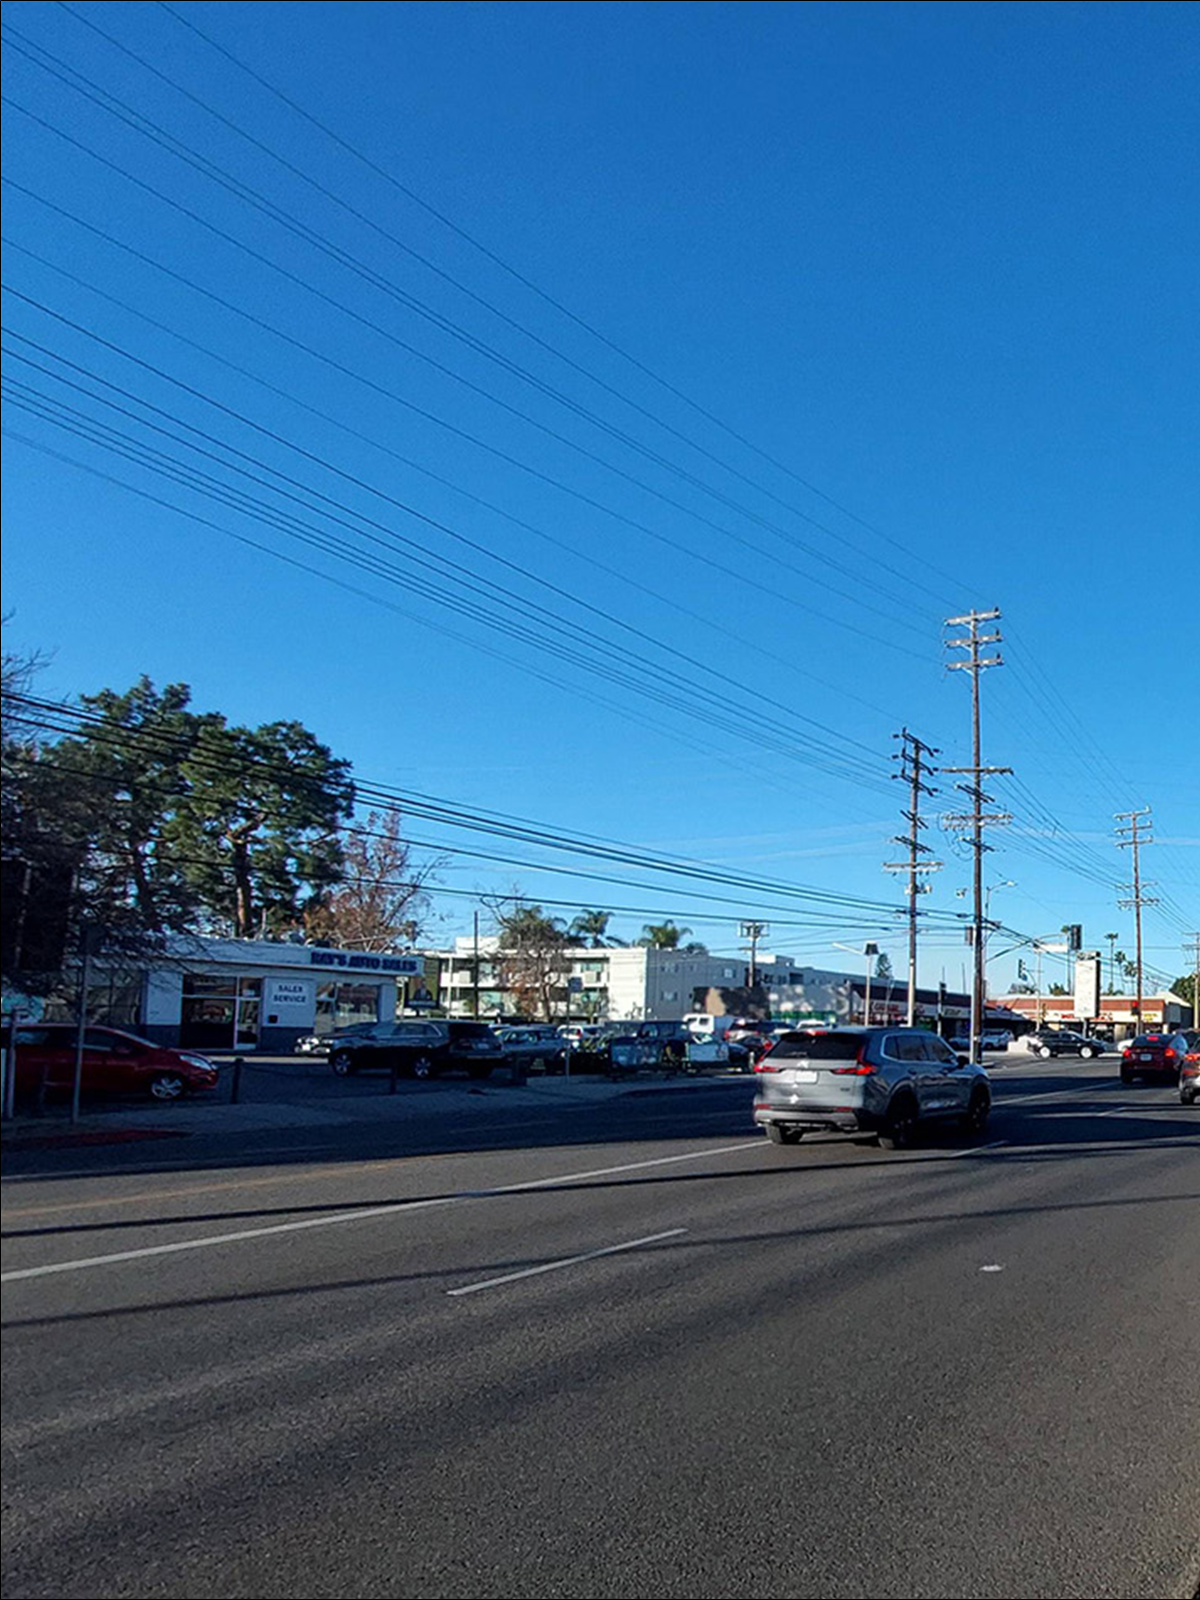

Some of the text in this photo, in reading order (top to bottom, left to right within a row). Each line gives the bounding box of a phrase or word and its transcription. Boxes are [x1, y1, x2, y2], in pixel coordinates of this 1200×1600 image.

[348, 955, 381, 969] AUTO
[382, 958, 418, 972] SALES
[273, 994, 306, 1003] SERVICE
